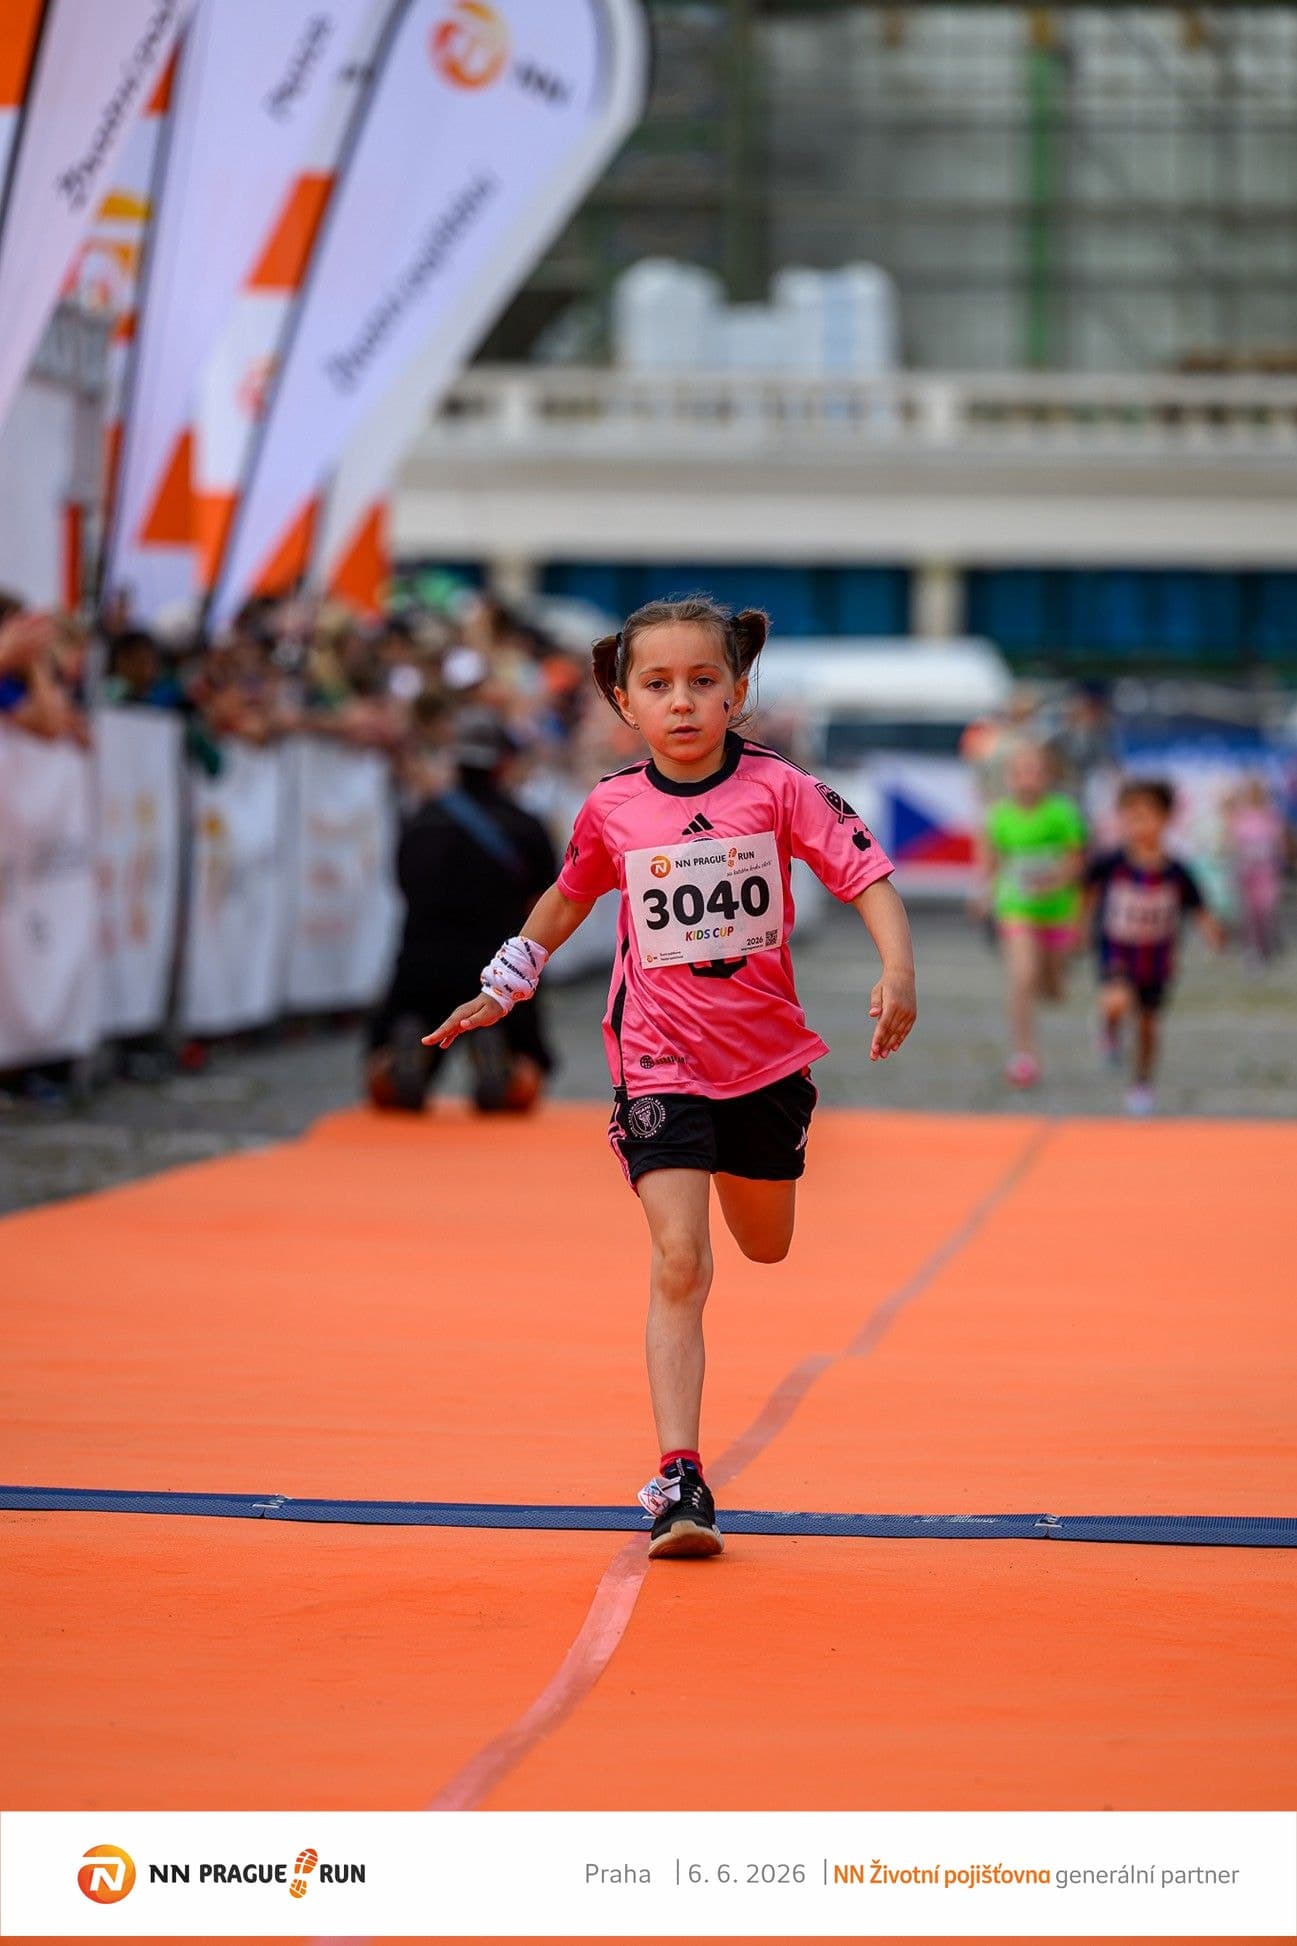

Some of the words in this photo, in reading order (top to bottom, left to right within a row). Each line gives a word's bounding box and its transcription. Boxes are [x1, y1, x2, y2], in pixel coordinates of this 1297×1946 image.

[675, 860, 691, 868] NN
[694, 854, 726, 866] PRAGUE
[738, 851, 755, 861] RUN
[643, 876, 770, 930] 3040
[685, 929, 710, 941] KIDS
[712, 926, 734, 938] CUP
[746, 936, 764, 946] 2026
